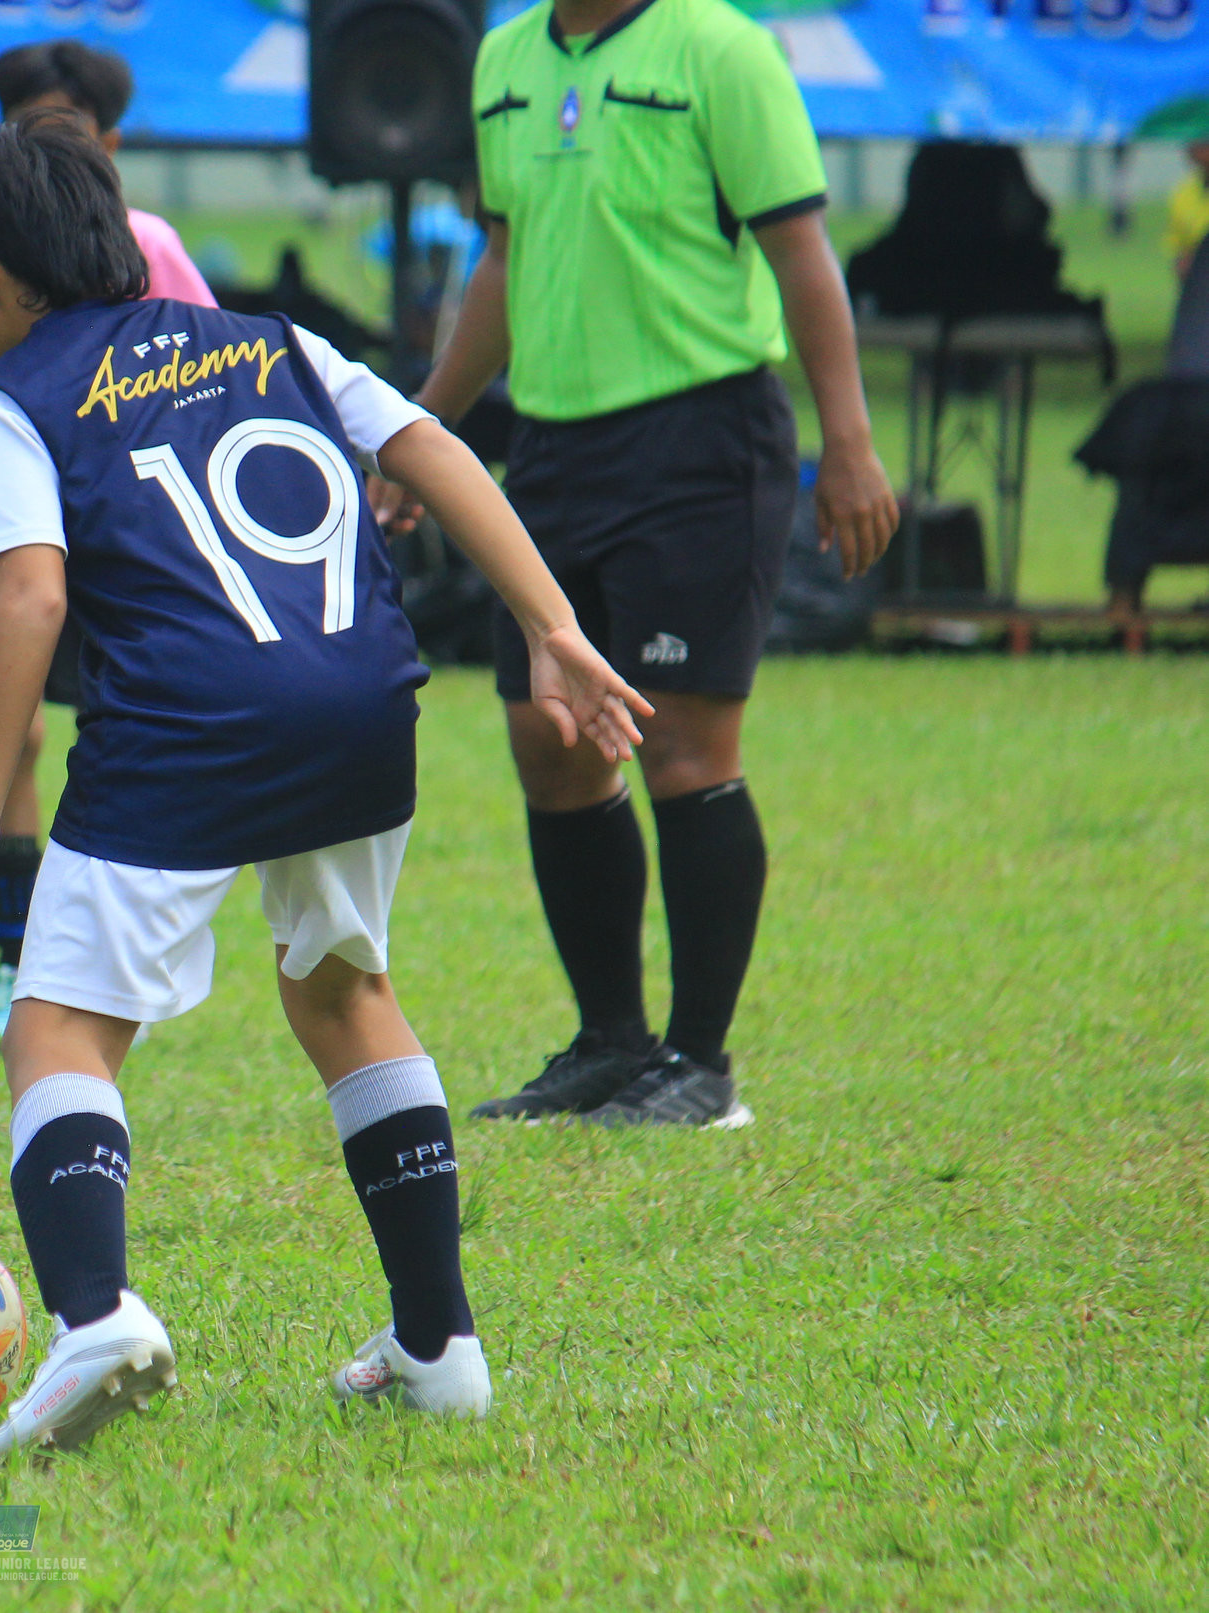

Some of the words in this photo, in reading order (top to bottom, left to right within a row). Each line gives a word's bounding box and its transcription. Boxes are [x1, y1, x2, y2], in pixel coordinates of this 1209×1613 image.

[133, 331, 189, 358] FFF
[76, 337, 288, 422] Academy
[173, 385, 226, 409] JAKARTA
[129, 417, 360, 643] 19
[396, 1141, 447, 1168] FFF
